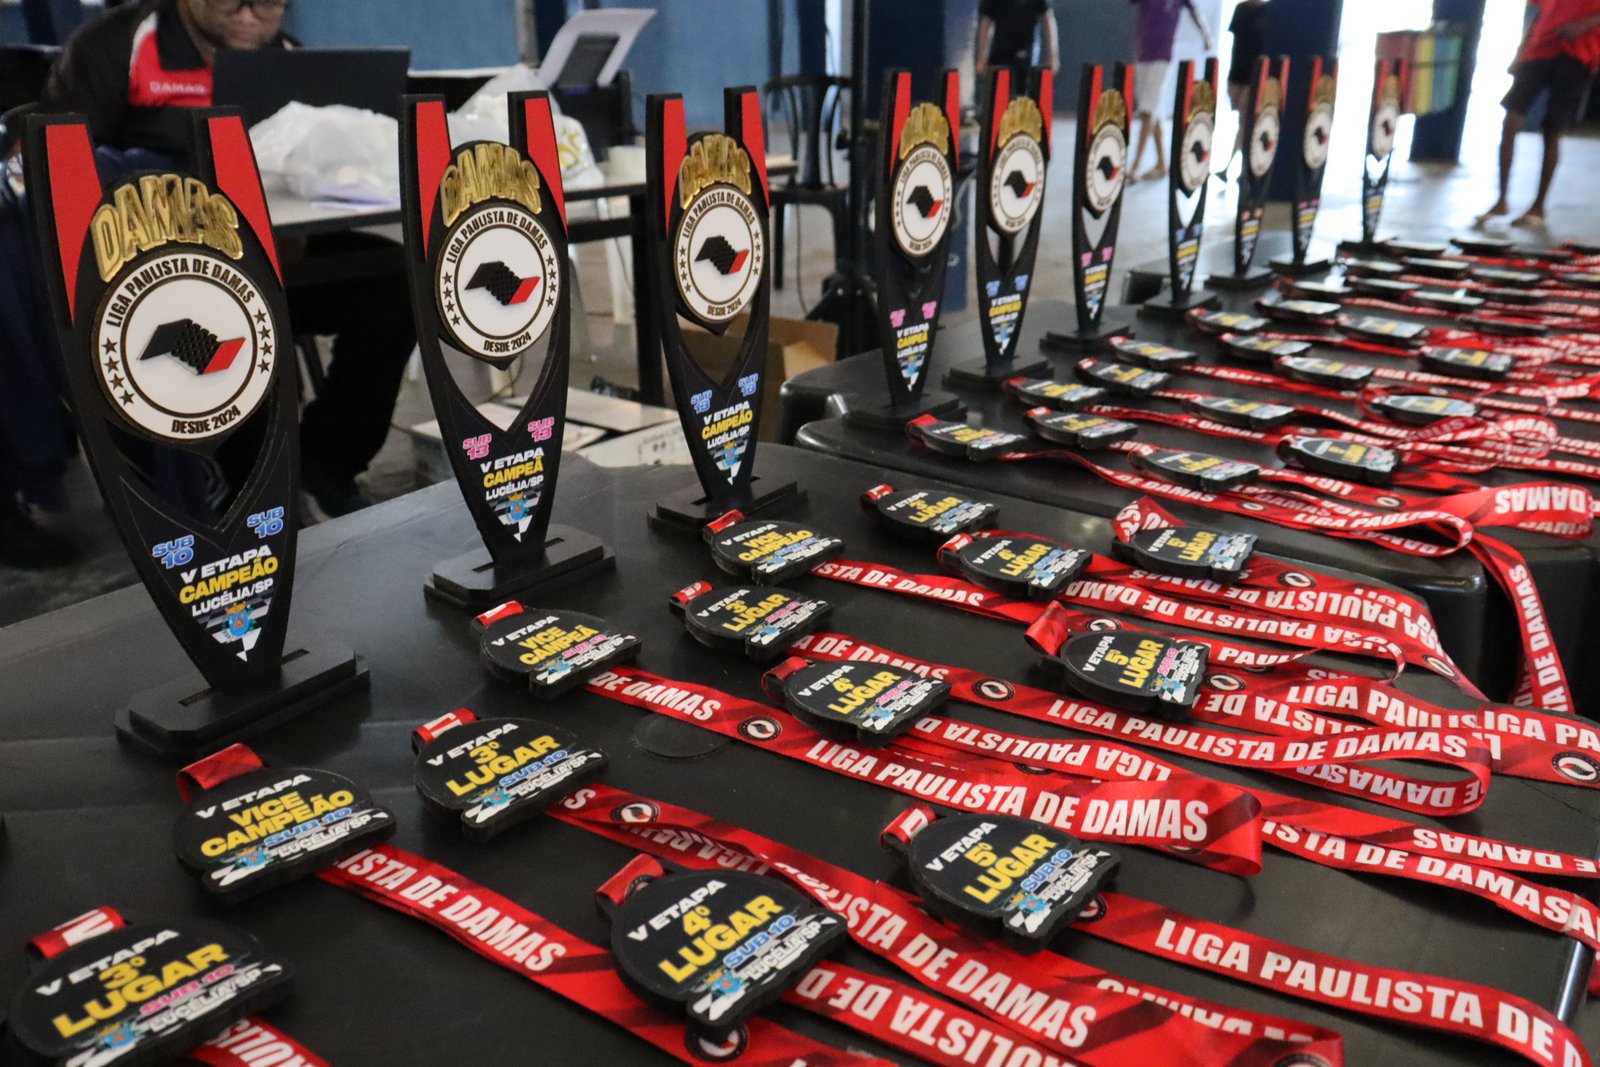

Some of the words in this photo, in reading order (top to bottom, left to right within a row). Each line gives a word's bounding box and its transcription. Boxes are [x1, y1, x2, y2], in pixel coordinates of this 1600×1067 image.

[90, 174, 244, 282] DAMAS
[446, 237, 465, 264] LIGA
[461, 210, 504, 240] PAULISTA
[506, 211, 518, 225] DE
[518, 215, 548, 250] DAMAS
[106, 291, 132, 328] LIGA
[124, 257, 189, 298] PAULISTA
[192, 258, 210, 275] DE
[212, 265, 255, 304] DAMAS
[483, 338, 511, 352] DESDE
[511, 331, 532, 350] 2024
[171, 418, 211, 434] DESDE
[211, 404, 242, 429] 2024
[527, 416, 555, 432] SUB
[703, 414, 712, 425] V
[713, 400, 750, 422] ETAPA
[463, 433, 492, 449] SUB
[467, 442, 489, 460] 13
[531, 426, 552, 442] 13
[480, 461, 492, 473] V
[494, 446, 545, 470] ETAPA
[483, 456, 545, 488] CAMPEÃ
[486, 475, 544, 501] LUCÉLIA/SP
[1495, 485, 1589, 515] DAMAS
[247, 506, 284, 528] SUB
[254, 518, 284, 538] 10
[152, 534, 195, 557] SUB
[161, 547, 194, 570] 10
[1000, 543, 1052, 576] LUGAR
[179, 556, 279, 604] CAMPEÃO
[180, 568, 198, 584] V
[201, 544, 272, 578] ETAPA
[191, 577, 274, 617] LUCÉLIA/SP
[696, 609, 710, 617] V
[708, 589, 750, 612] ETAPA
[860, 569, 898, 587] DE
[893, 578, 985, 606] DAMAS
[1065, 580, 1142, 606] DAMA
[1143, 594, 1180, 617] DE
[721, 593, 791, 632] LUGAR
[1184, 605, 1318, 640] PAULISTA
[1264, 588, 1398, 629] PAULISTA
[1508, 564, 1551, 652] DAMAS
[491, 637, 505, 647] V
[505, 615, 560, 641] ETAPA
[518, 625, 568, 650] VICE
[519, 624, 600, 665] CAMPEÃ
[812, 635, 854, 658] DE
[1082, 662, 1096, 672] V
[1088, 635, 1116, 666] ETAPA
[1119, 639, 1165, 689] LUGAR
[797, 687, 812, 697] V
[809, 664, 855, 690] ETAPA
[1534, 651, 1562, 687] DE
[588, 670, 633, 692] DE
[620, 682, 721, 721] DAMAS
[827, 671, 902, 715] LUGAR
[1204, 693, 1248, 716] DE
[1286, 684, 1361, 710] LIGA
[426, 754, 444, 767] V
[446, 722, 519, 760] ETAPA
[942, 722, 1091, 767] PAULISTA
[1047, 699, 1118, 731] LIGA
[1121, 717, 1275, 762] PAULISTA
[1281, 740, 1329, 762] DE
[1333, 731, 1468, 759] DAMAS
[445, 735, 561, 797] LUGAR
[469, 741, 501, 765] 3º
[1094, 746, 1173, 782] LIGA
[499, 762, 544, 787] SUB
[805, 739, 878, 777] LIGA
[875, 762, 1028, 816] PAULISTA
[1030, 790, 1081, 830] DE
[1080, 799, 1209, 842] DAMAS
[196, 805, 217, 819] V
[221, 774, 313, 812] ETAPA
[228, 791, 305, 827] VICE
[201, 790, 354, 857] CAMPEÃO
[264, 820, 319, 847] SUB
[277, 813, 373, 858] LUCÉLIA/SP
[925, 858, 945, 873] V
[940, 821, 998, 864] ETAPA
[964, 842, 998, 868] 5º
[1412, 828, 1563, 869] DAMAS
[963, 833, 1057, 904] LUGAR
[1020, 862, 1055, 892] SUB
[1052, 848, 1073, 867] 10
[1355, 843, 1409, 870] DE
[1415, 861, 1572, 926] DAMAS
[399, 875, 459, 908] DE
[439, 895, 567, 971] DAMAS
[627, 924, 648, 942] V
[649, 879, 727, 931] ETAPA
[682, 905, 711, 936] 4º
[658, 895, 784, 983] LUGAR
[723, 932, 770, 968] SUB
[769, 914, 796, 937] 10
[35, 978, 62, 997] V
[68, 929, 180, 985] ETAPA
[99, 955, 146, 990] 3º
[52, 943, 230, 1039] LUGAR
[828, 976, 893, 1021] DE
[897, 933, 958, 982] DE
[947, 959, 1097, 1048] DAMAS
[1154, 918, 1250, 973] LIGA
[1259, 951, 1483, 1028] PAULISTA
[1496, 1001, 1554, 1063] DE
